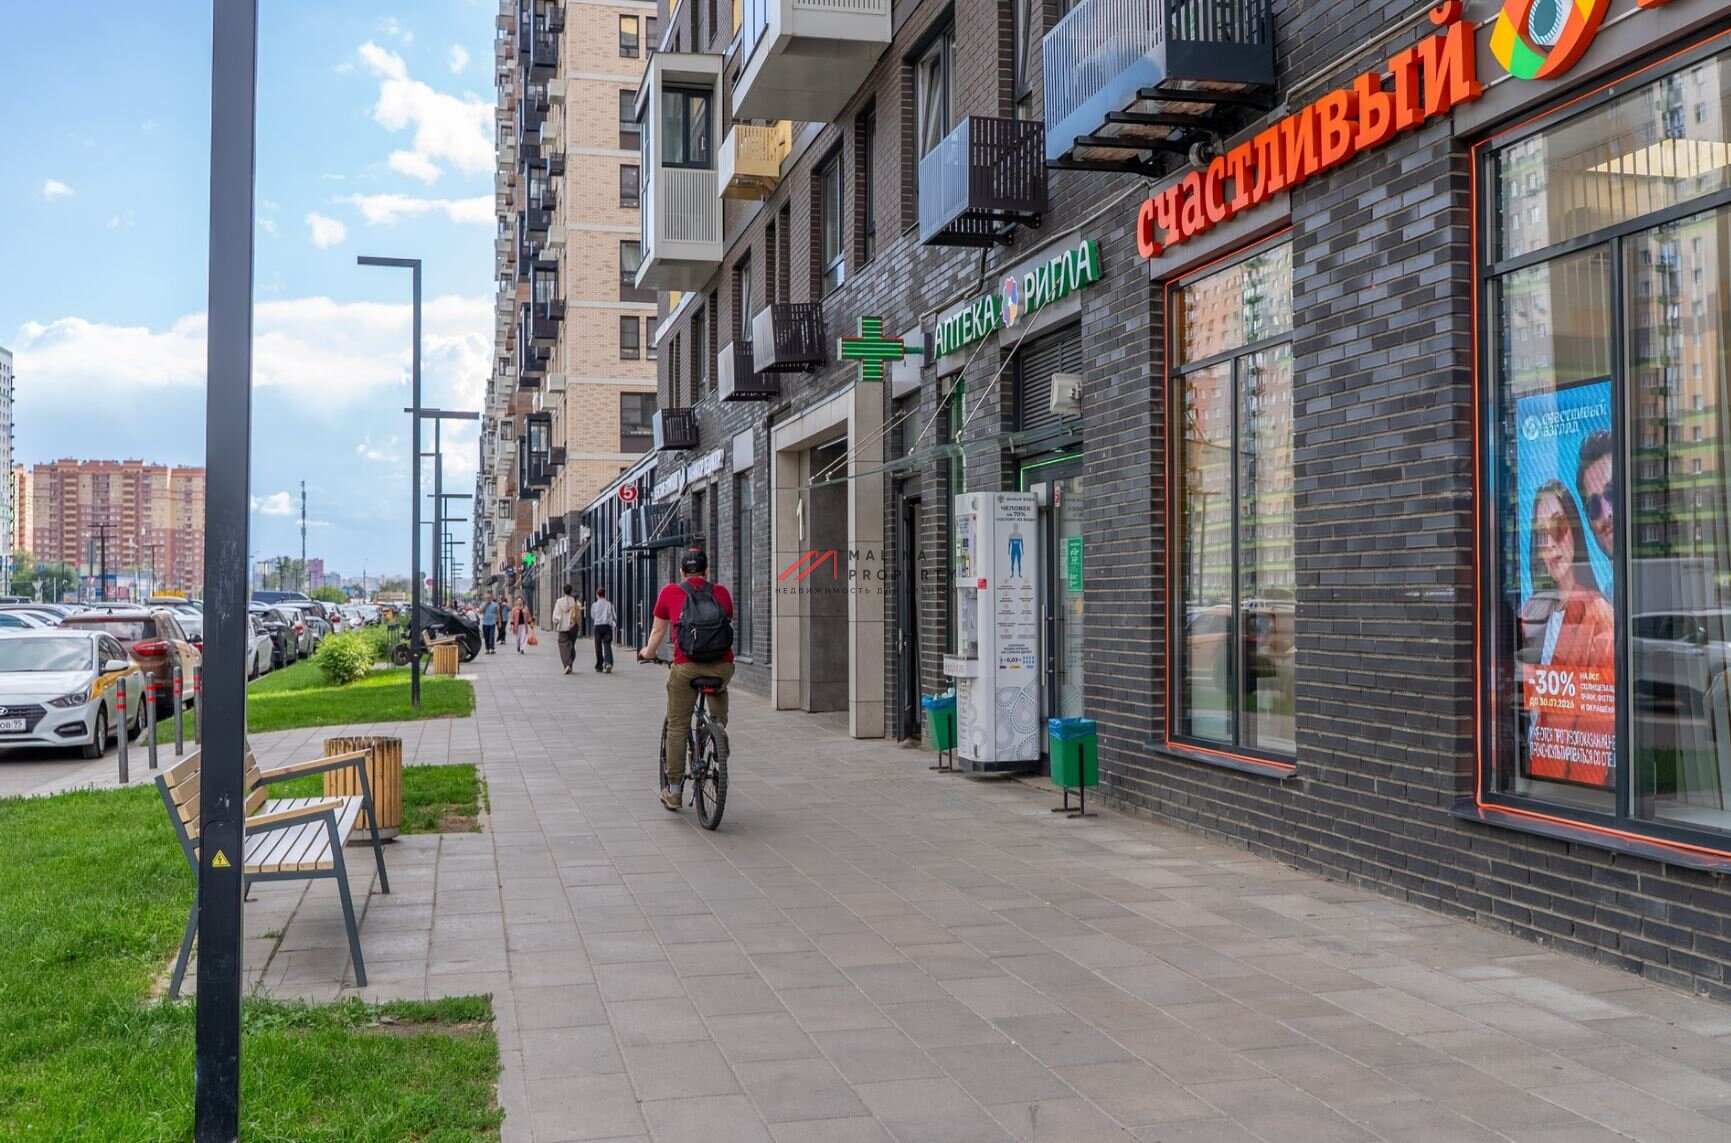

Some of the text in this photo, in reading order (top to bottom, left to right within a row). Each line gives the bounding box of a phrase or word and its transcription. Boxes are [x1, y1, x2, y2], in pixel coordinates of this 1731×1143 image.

[934, 240, 1099, 359] АПТЕКА РИГЛА
[623, 484, 634, 500] 5
[796, 498, 803, 541] 1
[1528, 670, 1576, 697] -30%
[1579, 672, 1588, 680] НА
